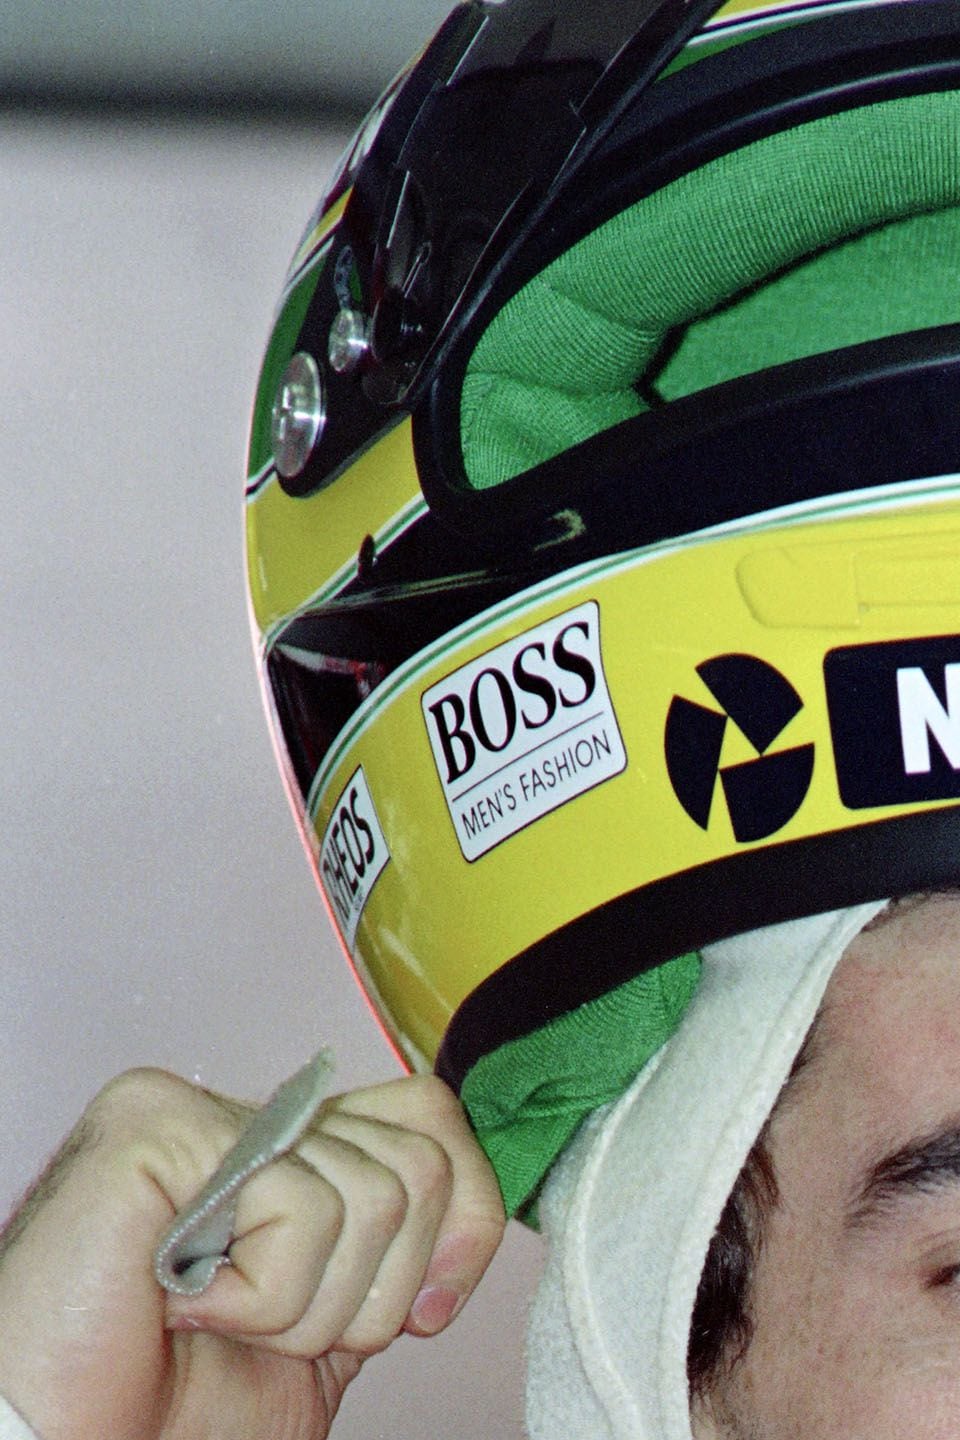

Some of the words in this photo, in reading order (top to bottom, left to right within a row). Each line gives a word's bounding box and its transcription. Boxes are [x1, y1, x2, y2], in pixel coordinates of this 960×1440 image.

[429, 622, 595, 783] BOSS
[462, 784, 517, 839] MEN'S
[519, 730, 612, 801] FASHION
